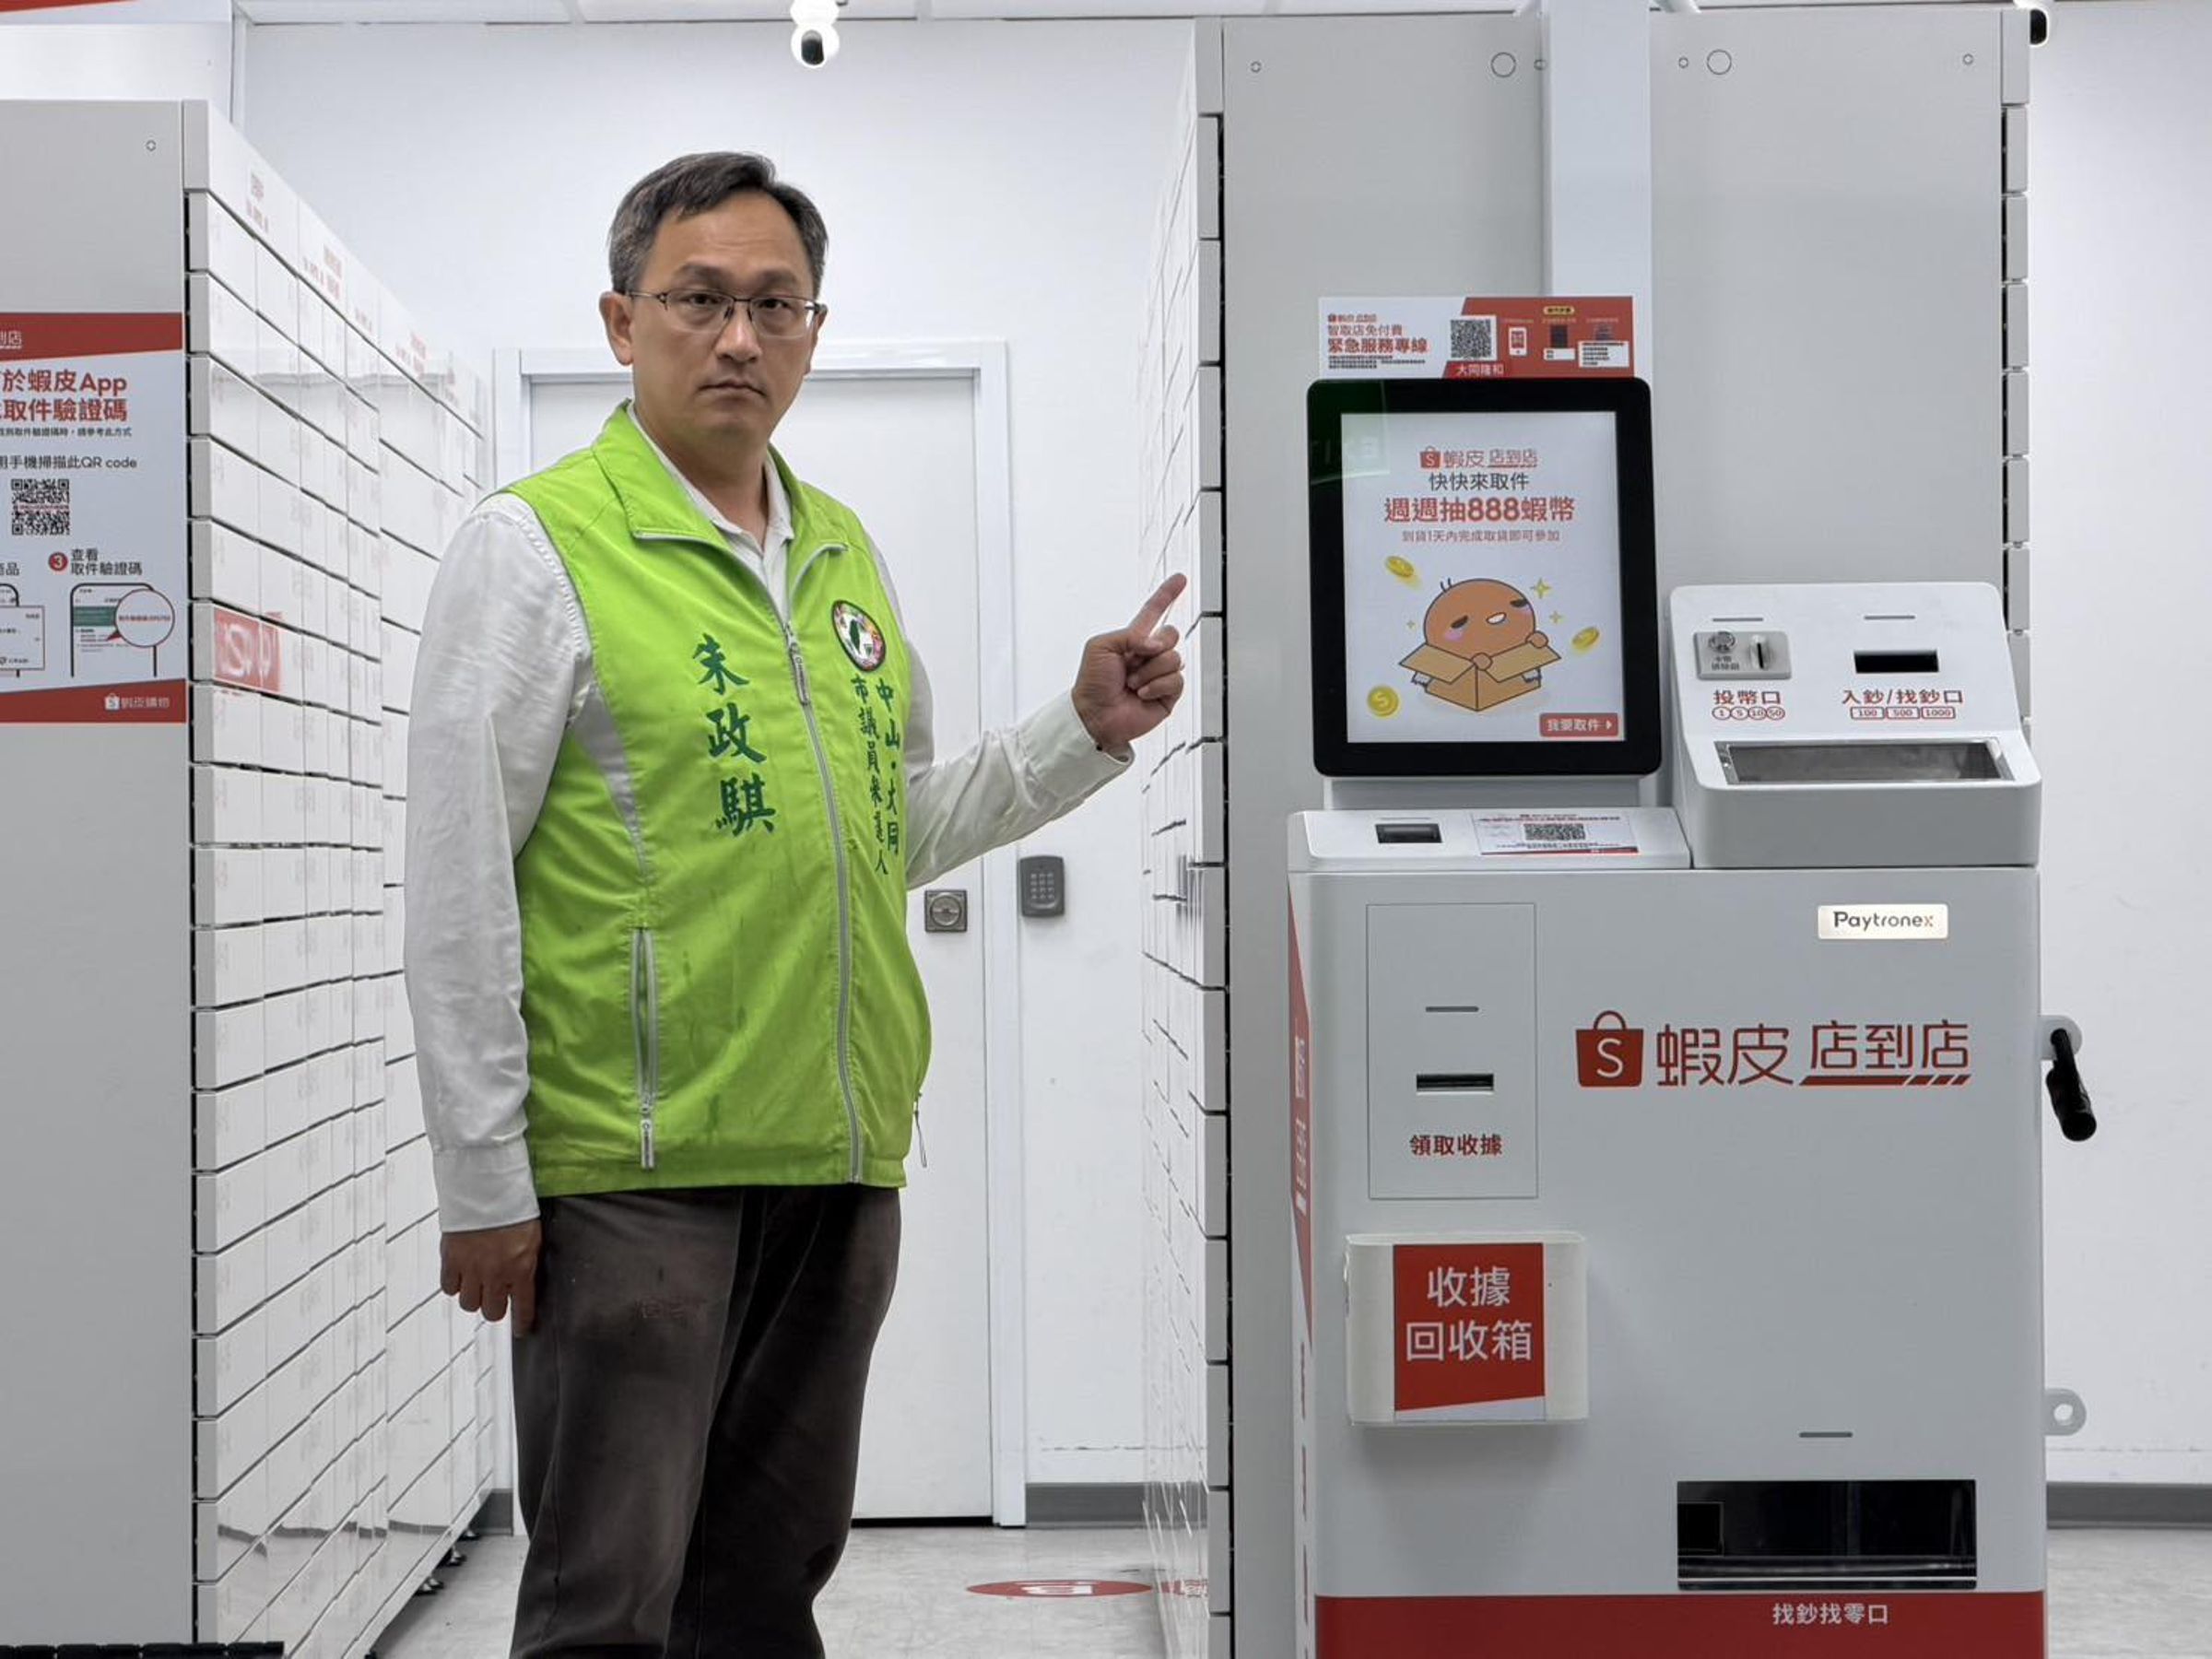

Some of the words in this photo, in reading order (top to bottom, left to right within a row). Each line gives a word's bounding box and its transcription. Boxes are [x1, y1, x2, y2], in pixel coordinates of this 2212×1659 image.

[1327, 338, 1428, 353] 緊急服務專線
[0, 398, 127, 421] 取件驗證碼
[105, 457, 137, 468] code
[1444, 449, 1487, 467] 蝦皮
[1489, 449, 1538, 465] 店到店
[1429, 472, 1530, 491] 快快來取件
[1384, 497, 1576, 523] 週週抽888蝦幣
[1402, 529, 1560, 543] 到貨1天內完成取貨即可參加
[71, 548, 99, 561] 查看
[71, 562, 142, 576] 取件驗證碼
[1713, 689, 1782, 705] 投幣口
[1841, 688, 1963, 704] 入鈔/找鈔口
[1833, 911, 1934, 932] Paytronex
[1655, 1022, 1794, 1087] 蝦皮
[1810, 1019, 1970, 1070] 店到店
[1409, 1135, 1502, 1157] 領取收據
[1426, 1265, 1512, 1308] 收據
[1406, 1319, 1533, 1362] 回收箱
[1772, 1602, 1888, 1627] 找鈔找零口
